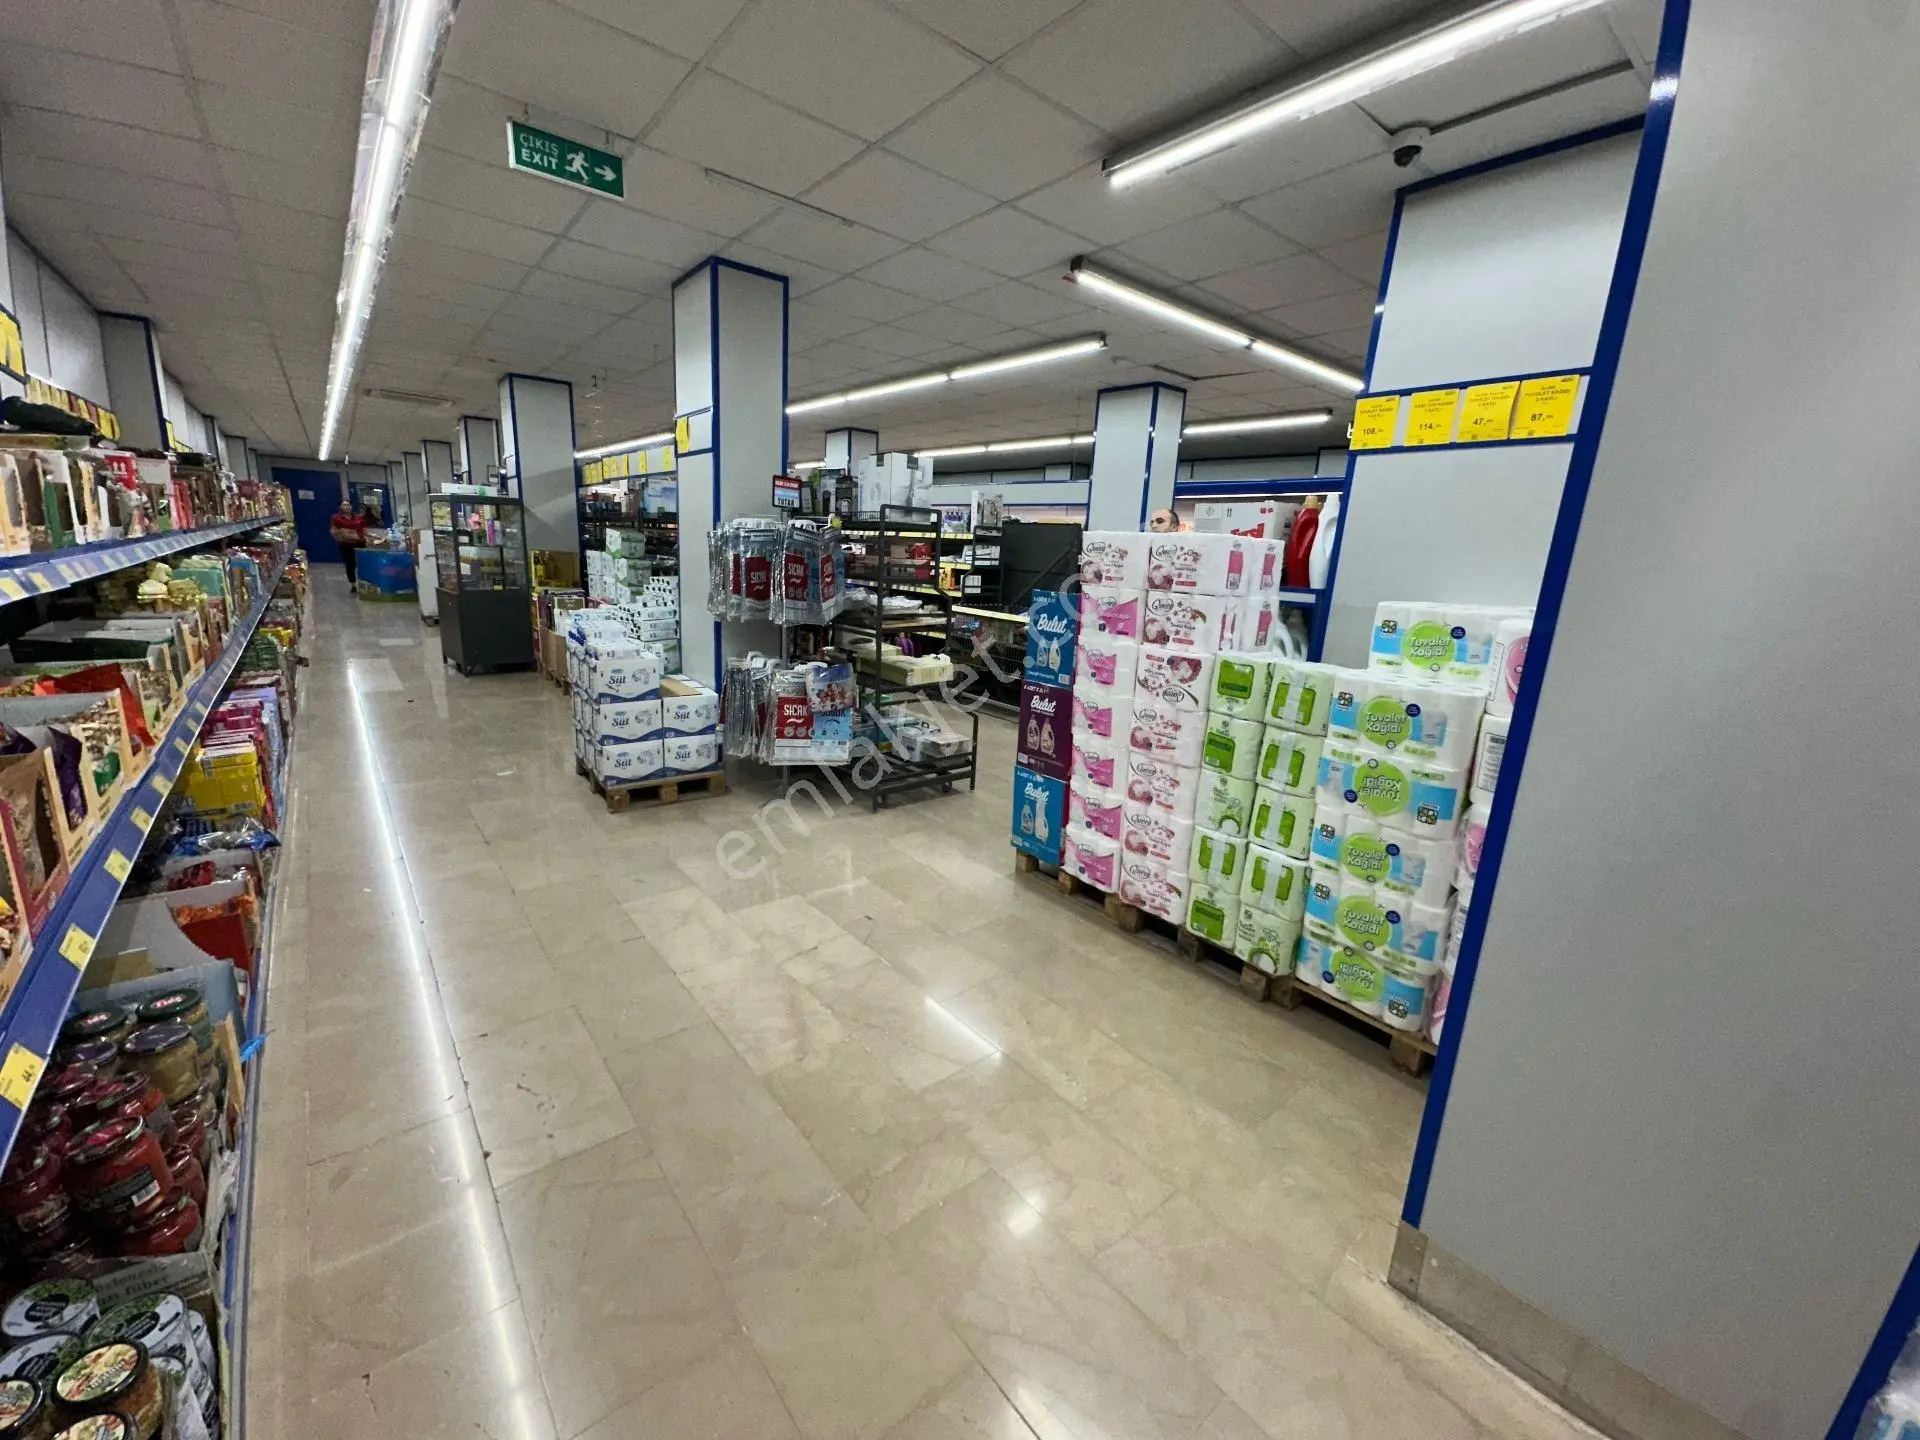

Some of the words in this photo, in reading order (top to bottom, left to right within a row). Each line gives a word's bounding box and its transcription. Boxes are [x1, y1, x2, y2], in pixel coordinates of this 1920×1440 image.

[520, 133, 559, 158] ÇIKIŞ
[522, 149, 558, 170] EXIT
[1151, 598, 1174, 611] Queen
[1037, 613, 1068, 634] Bulut
[1410, 636, 1451, 647] Tuvalet
[1409, 645, 1448, 659] Kağıdı
[608, 674, 627, 685] Süt
[1030, 694, 1057, 713] Bulut
[673, 710, 690, 720] Süt
[783, 704, 808, 717] SICAK
[611, 717, 630, 727] Süt
[1366, 712, 1408, 723] Tuvalet
[1365, 721, 1402, 736] Kağıdı
[674, 749, 692, 760] Süt
[614, 758, 632, 768] Süt
[1347, 846, 1388, 861] Tuvalet
[1343, 907, 1384, 926] Tuvalet
